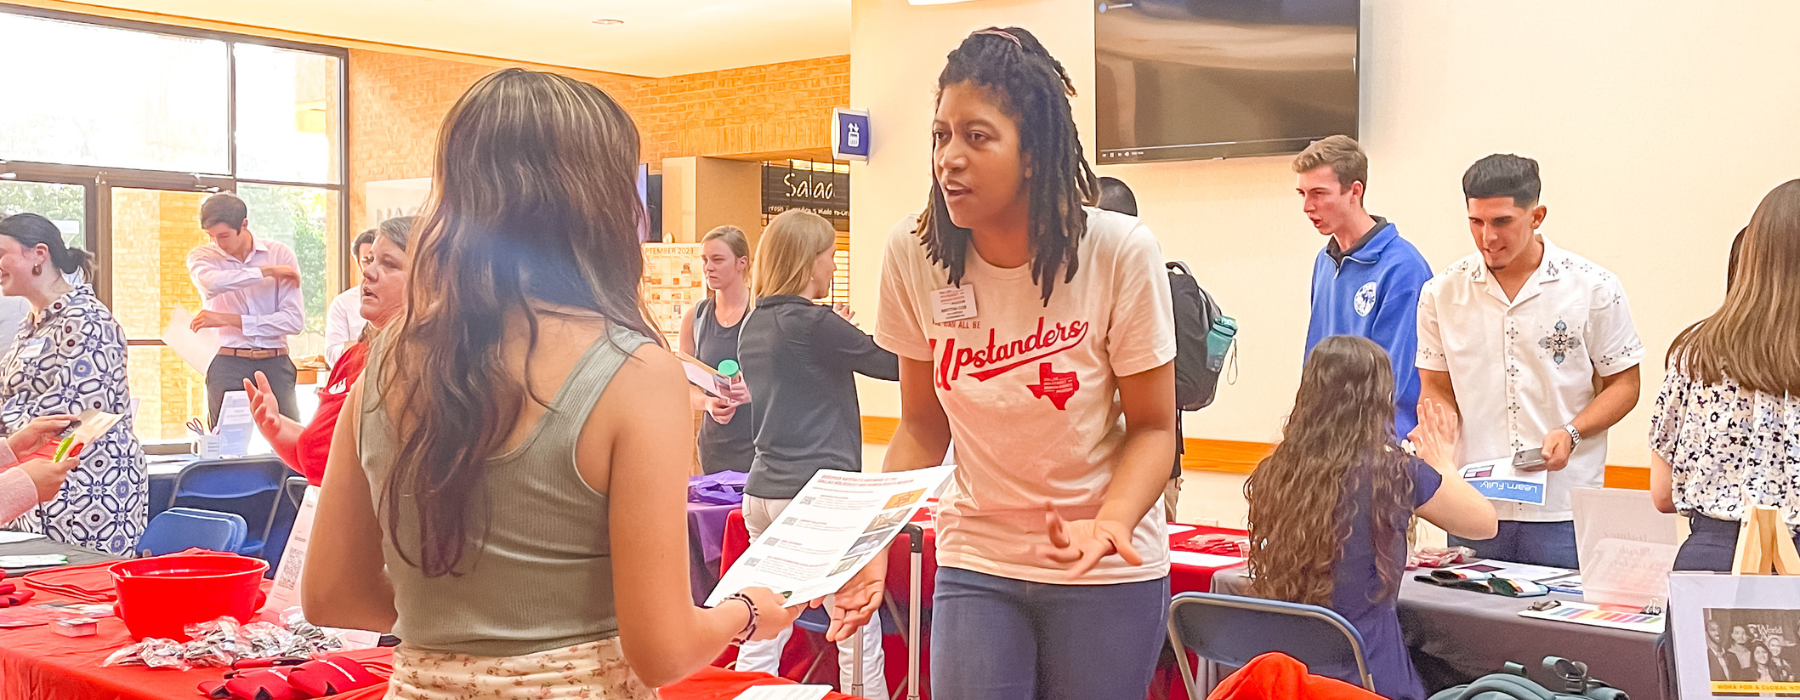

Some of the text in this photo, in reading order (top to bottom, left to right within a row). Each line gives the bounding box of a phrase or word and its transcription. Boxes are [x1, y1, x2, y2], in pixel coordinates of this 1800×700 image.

[645, 247, 677, 255] PTEMBER
[958, 320, 970, 329] ALL
[972, 320, 981, 329] BE
[928, 316, 1089, 391] Upstanders
